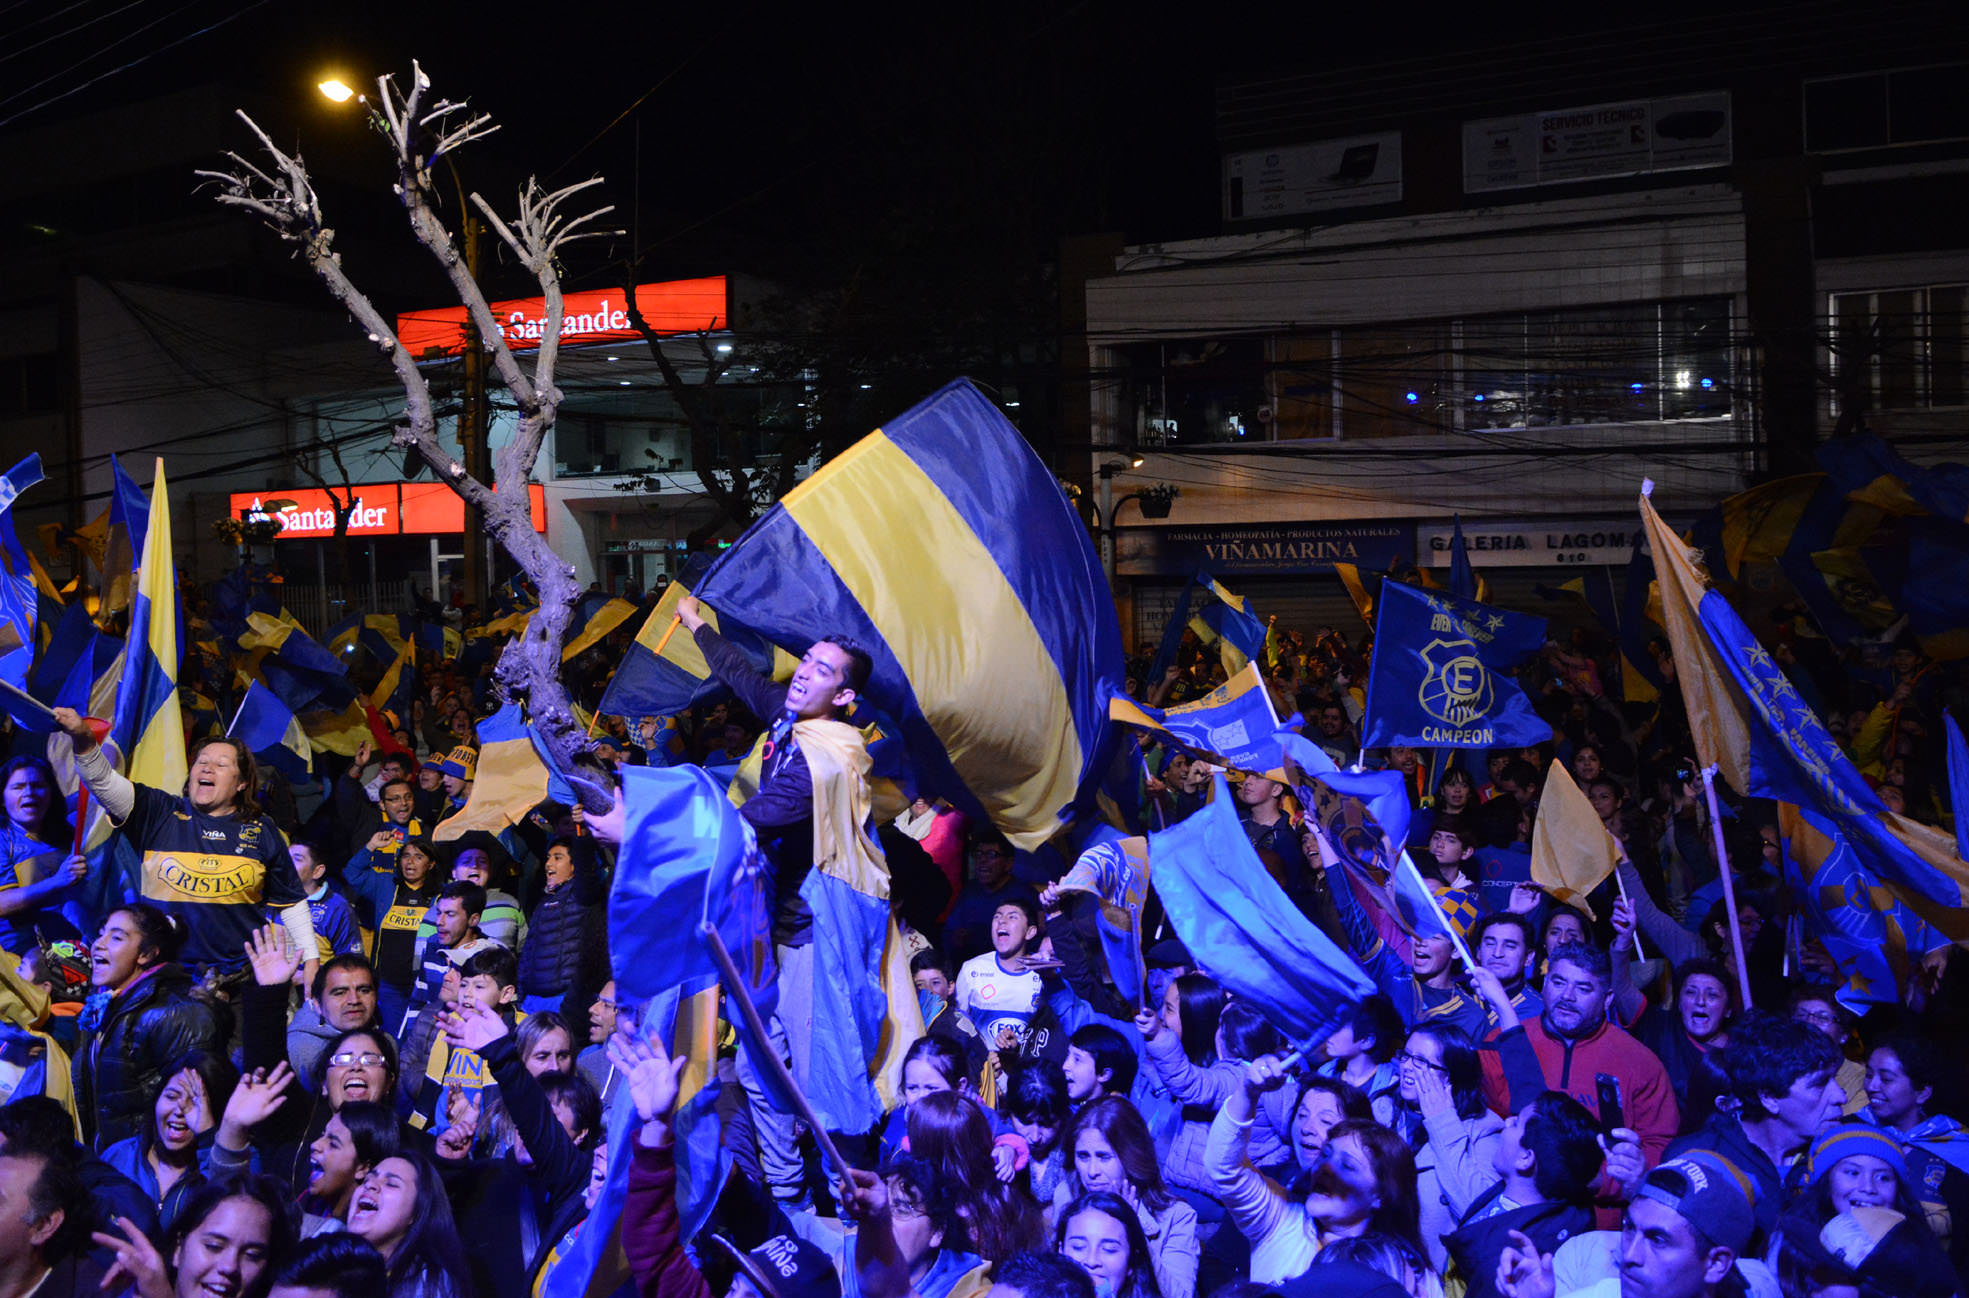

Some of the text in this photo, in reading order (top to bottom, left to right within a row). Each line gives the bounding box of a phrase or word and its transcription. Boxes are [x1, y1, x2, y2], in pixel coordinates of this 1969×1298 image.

[1543, 115, 1594, 130] SERVICIO
[509, 300, 632, 339] Saander
[275, 498, 387, 531] Santader
[1168, 533, 1214, 541] FARMACIA
[1287, 529, 1343, 538] PRODUCTOS
[1345, 528, 1401, 537] NATURALES
[1205, 539, 1359, 560] VIÑAMARINA
[1421, 726, 1493, 745] CAMPEON
[166, 865, 250, 893] CRISTAL
